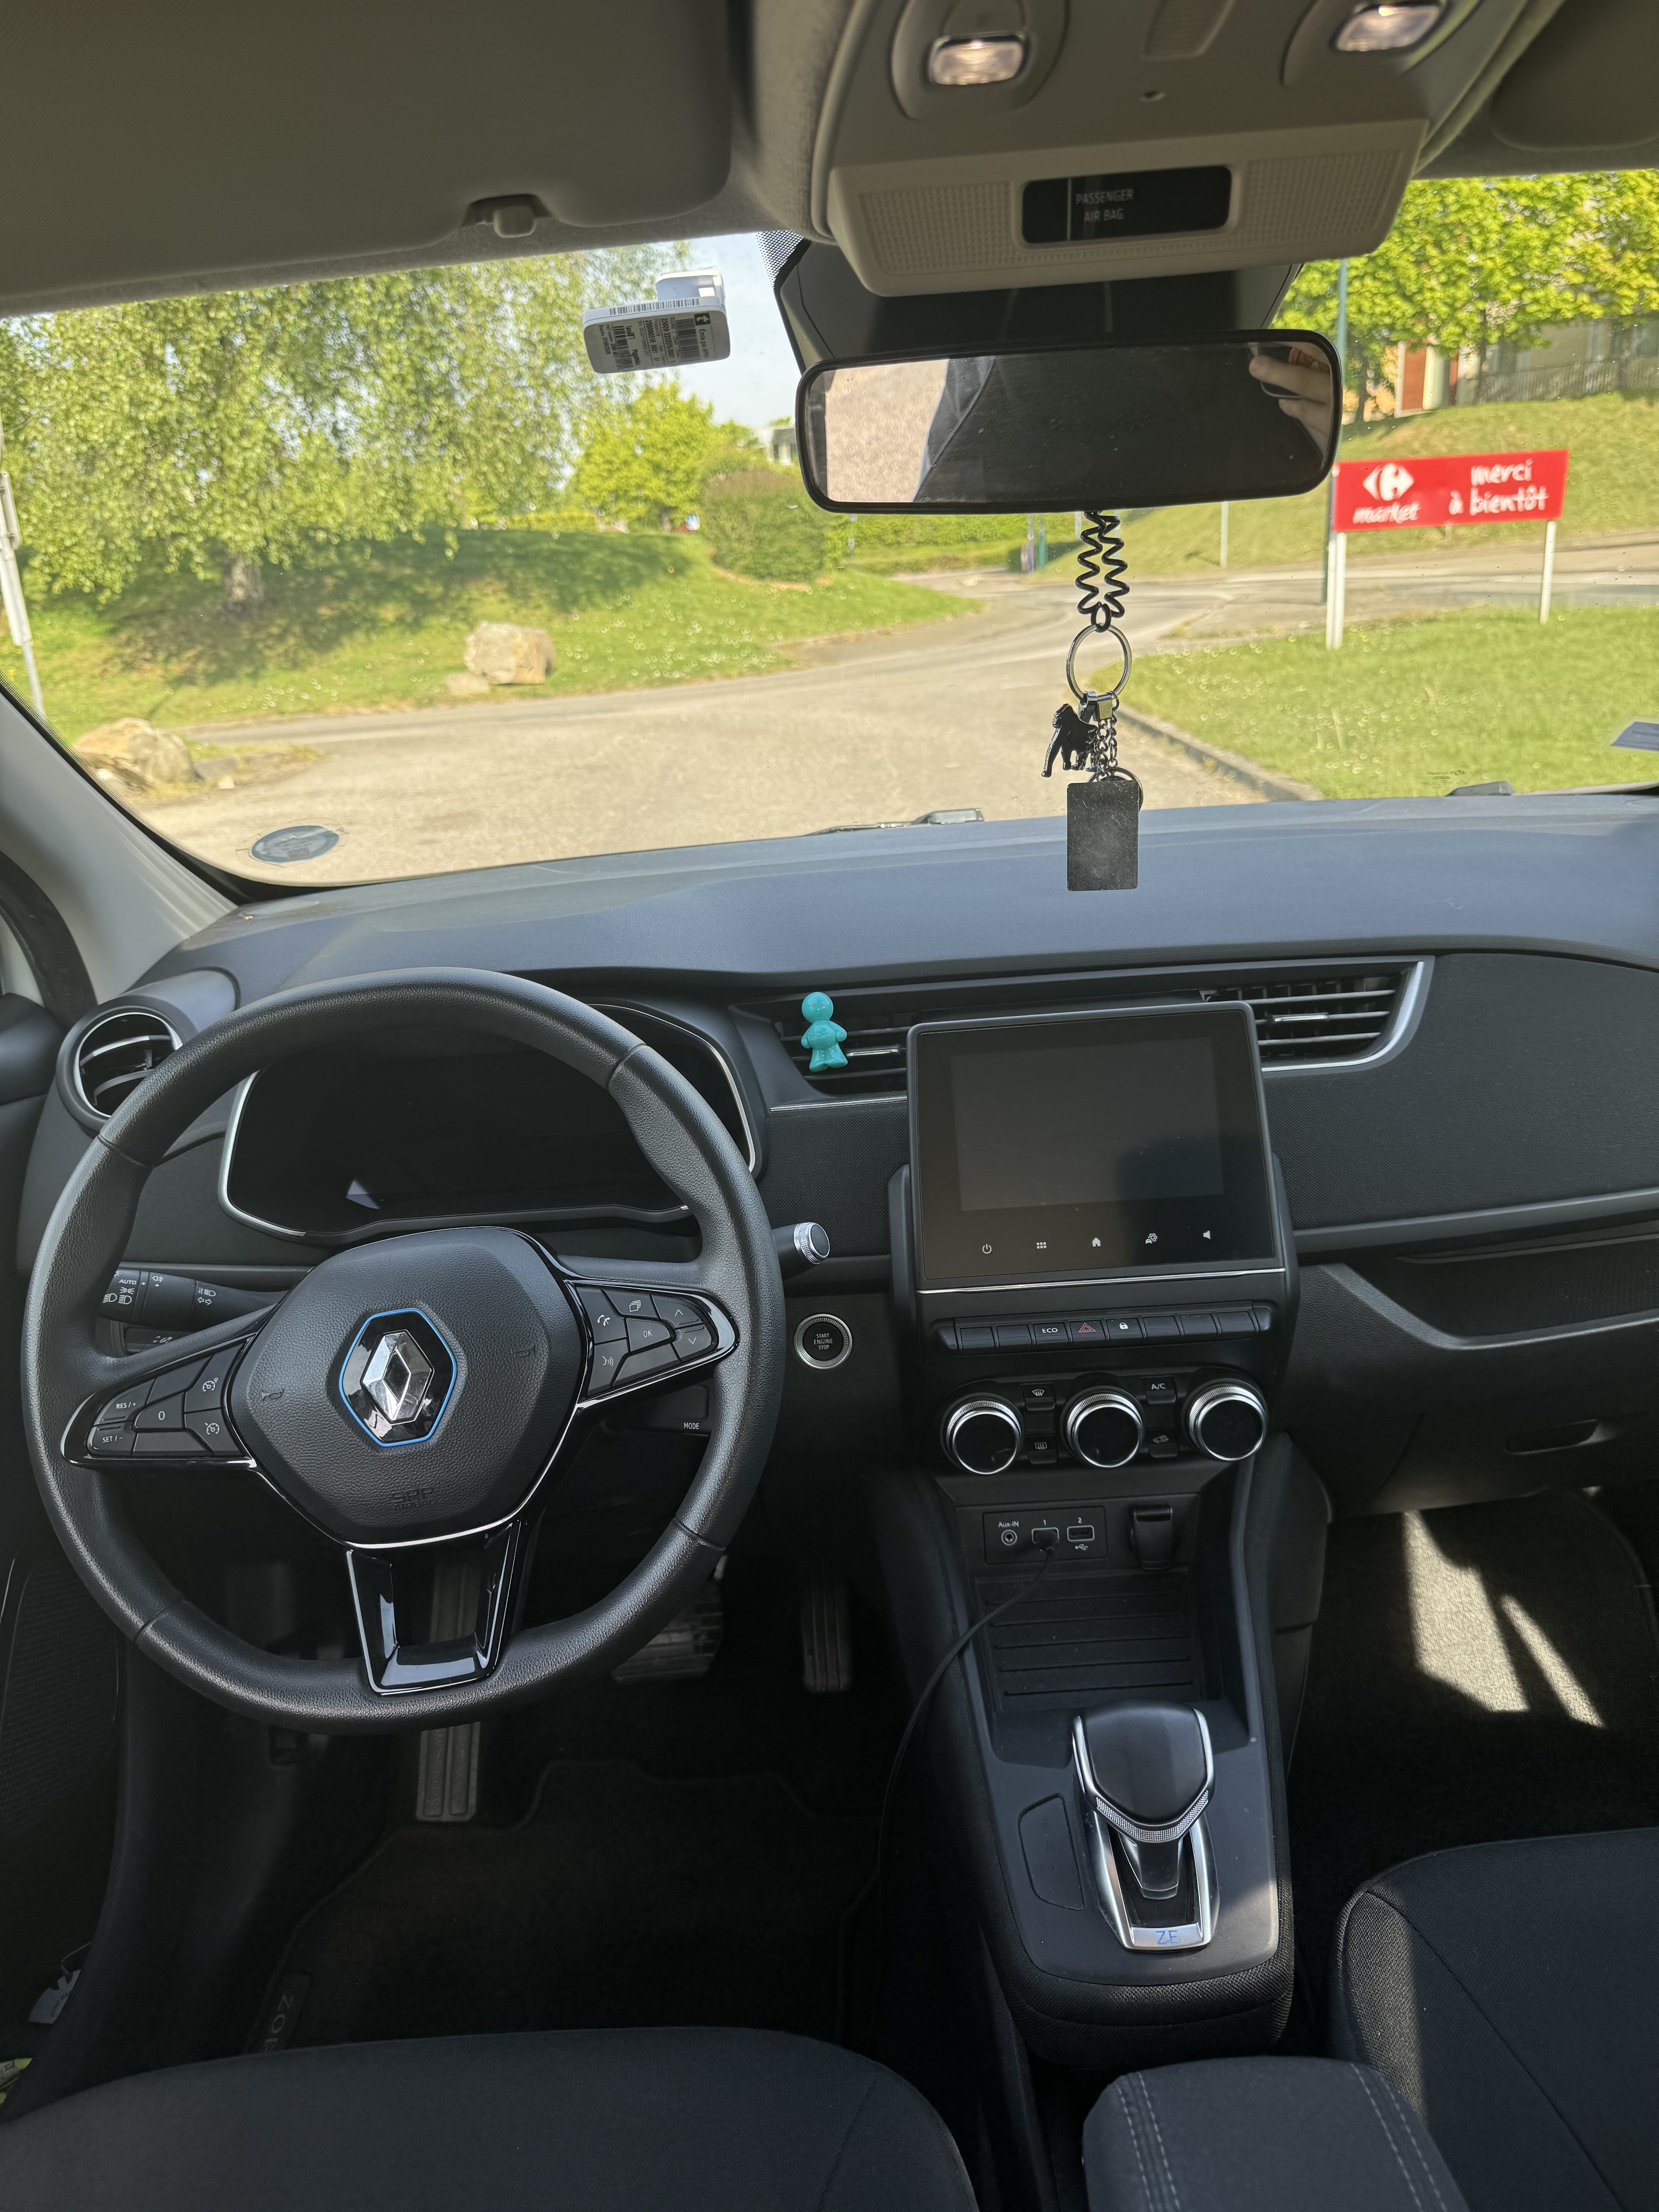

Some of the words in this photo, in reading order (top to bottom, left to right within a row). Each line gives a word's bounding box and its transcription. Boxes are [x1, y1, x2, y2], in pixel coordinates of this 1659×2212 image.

[1076, 189, 1133, 204] PASSENGER
[1084, 211, 1100, 223] AIR
[1104, 209, 1124, 221] BAG
[1470, 459, 1533, 487] merci
[1449, 490, 1463, 516] à
[1469, 484, 1549, 516] bientôt
[1352, 501, 1421, 524] market
[643, 1330, 652, 1338] OK
[1155, 1930, 1180, 1945] ZE
